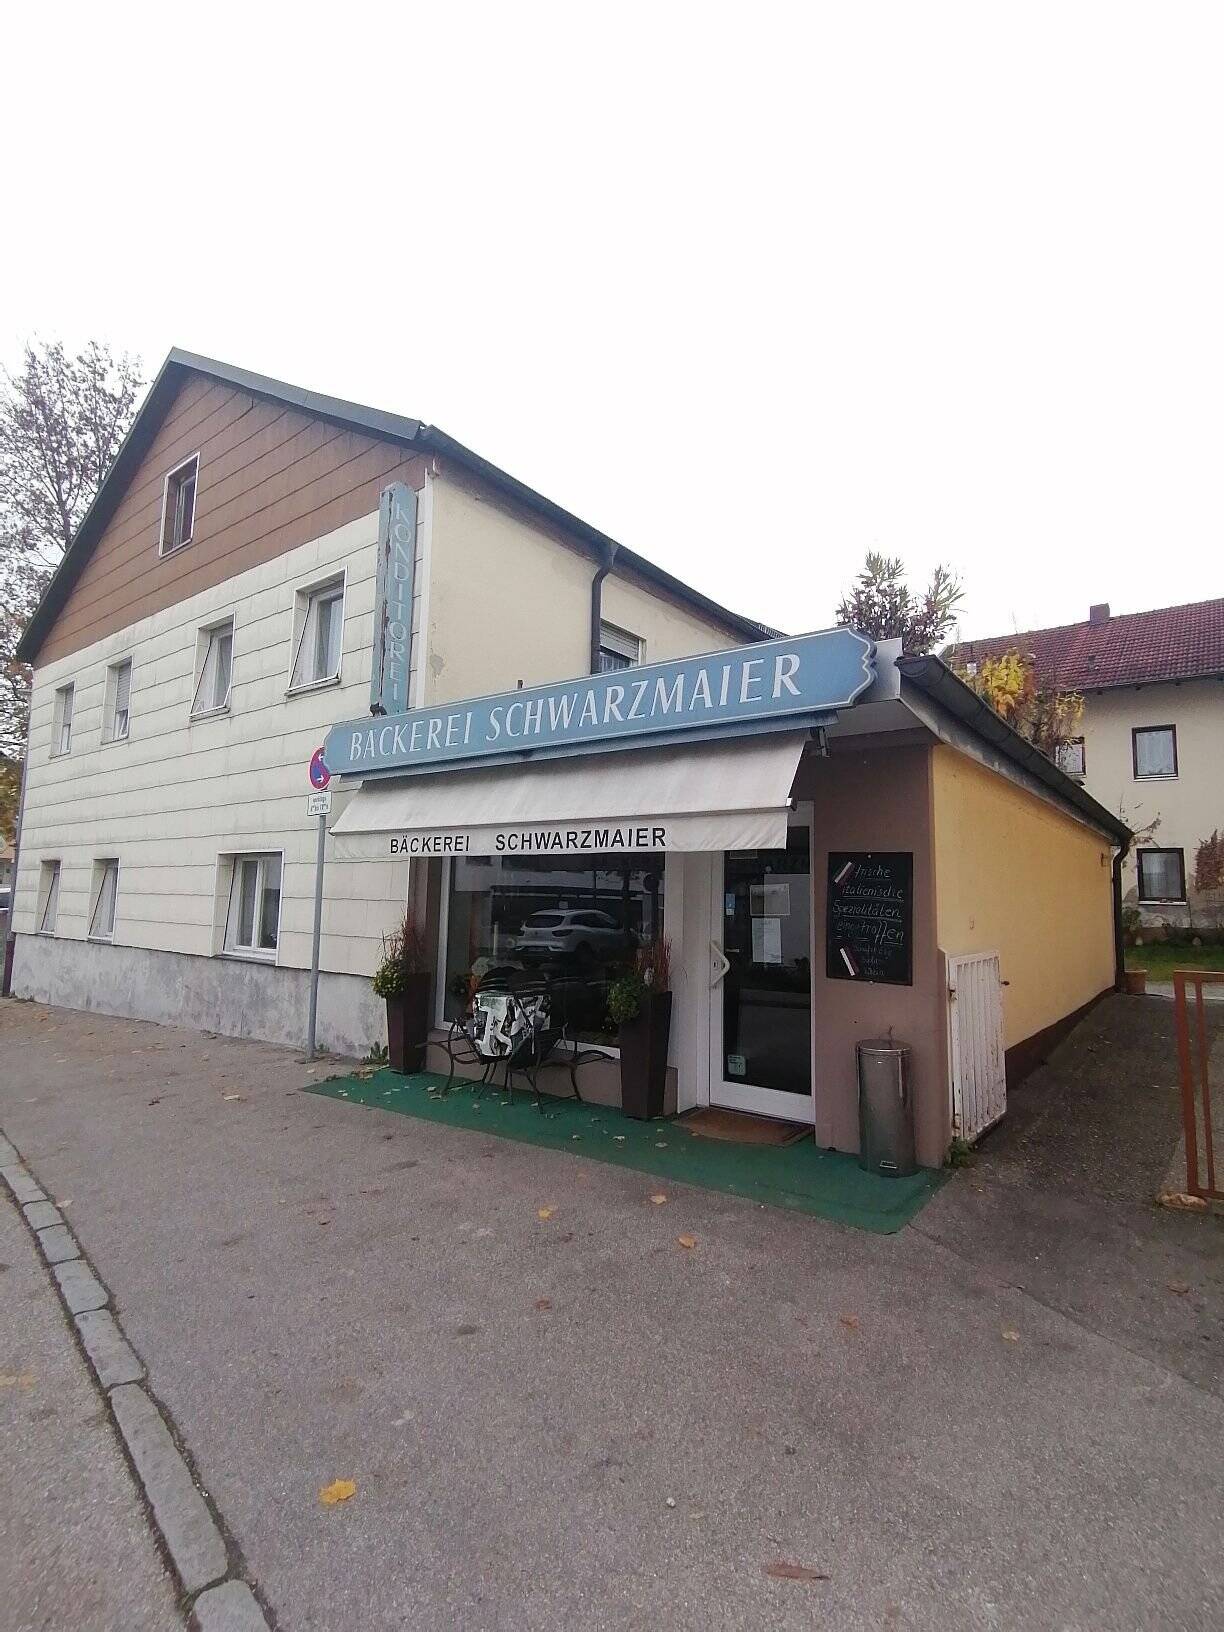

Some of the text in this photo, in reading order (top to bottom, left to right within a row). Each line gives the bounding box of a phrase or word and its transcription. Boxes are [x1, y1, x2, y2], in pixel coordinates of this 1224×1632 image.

[388, 503, 412, 701] KONDITOREI
[349, 653, 803, 761] BÄCKEREI SCHWARZMAIER
[390, 827, 667, 855] BÄCKEREI SCHWARZMAIER
